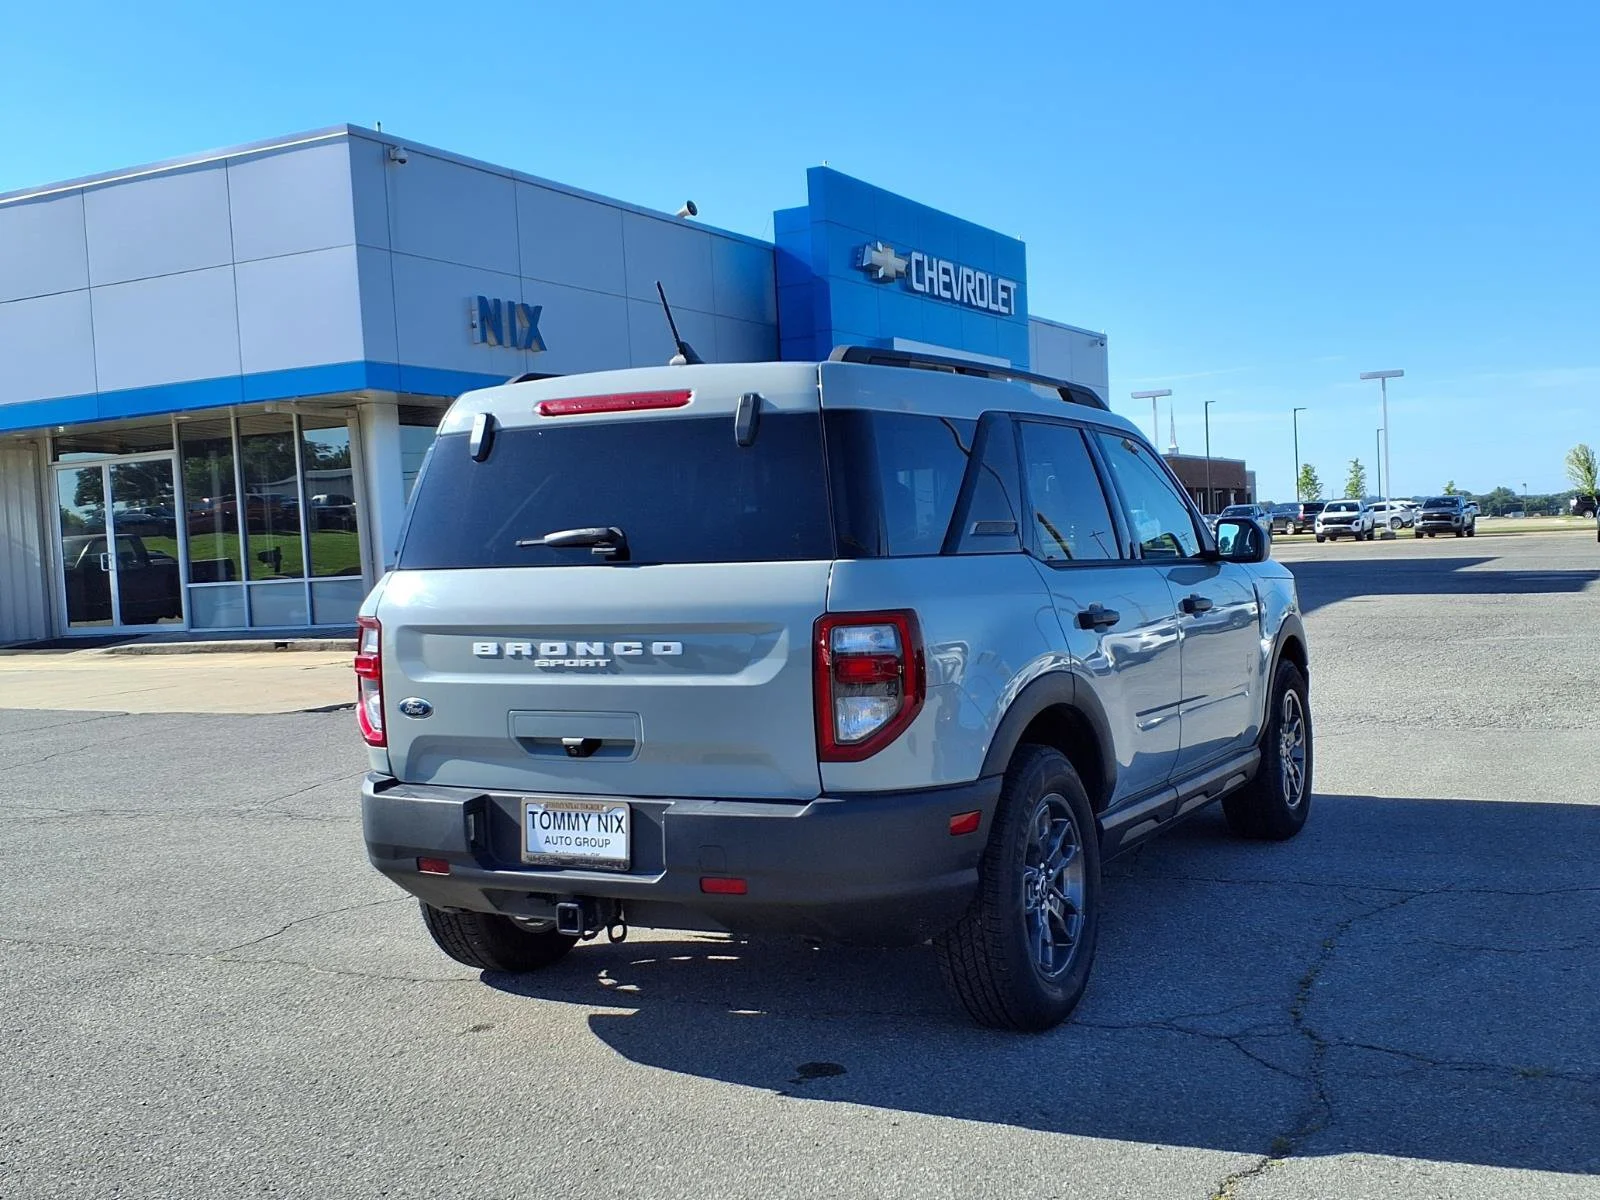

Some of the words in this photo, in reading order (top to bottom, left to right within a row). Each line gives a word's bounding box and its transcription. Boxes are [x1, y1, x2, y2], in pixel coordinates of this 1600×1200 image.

[911, 251, 1017, 315] CHEVROLET
[473, 295, 547, 352] NIX
[472, 641, 684, 656] BRONCO
[534, 658, 612, 668] SPORT
[528, 810, 592, 832] TOMMY
[597, 813, 625, 834] NIX
[544, 835, 572, 847] AUTO
[574, 836, 611, 848] GROUP
